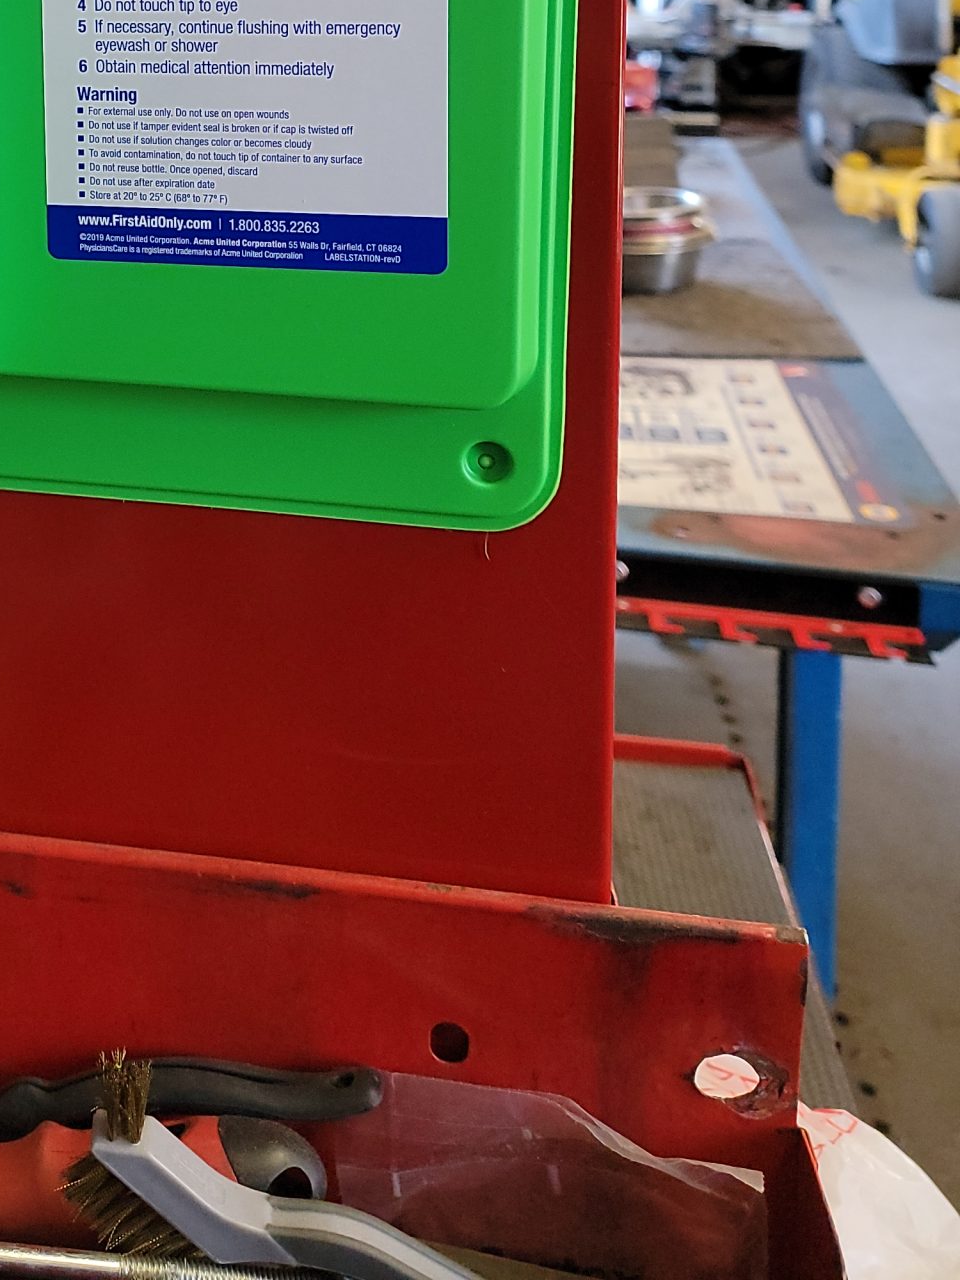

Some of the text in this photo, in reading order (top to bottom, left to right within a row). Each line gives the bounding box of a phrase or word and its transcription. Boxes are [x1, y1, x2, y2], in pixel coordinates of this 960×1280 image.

[215, 0, 238, 15] eye
[77, 19, 401, 39] 5 If necessary, continue flushing with emergency
[95, 38, 219, 55] eyewash or shower
[78, 59, 335, 79] 6 Obtain medical attention immediately
[76, 86, 137, 105] Warning
[88, 106, 290, 120] For external use only. Do not use on open wounds
[88, 134, 312, 151] Do not use if solution changes color or becomes cloudy
[89, 162, 258, 177] Do not reuse bottle. Once opened, discard
[89, 190, 112, 200] Store
[113, 191, 122, 200] at
[139, 192, 148, 201] to
[165, 192, 172, 202] C
[192, 193, 201, 203] to
[219, 194, 228, 206] F)
[77, 214, 212, 231] www.FirstAidOnly.com
[228, 218, 320, 234] 1.800.835.2263
